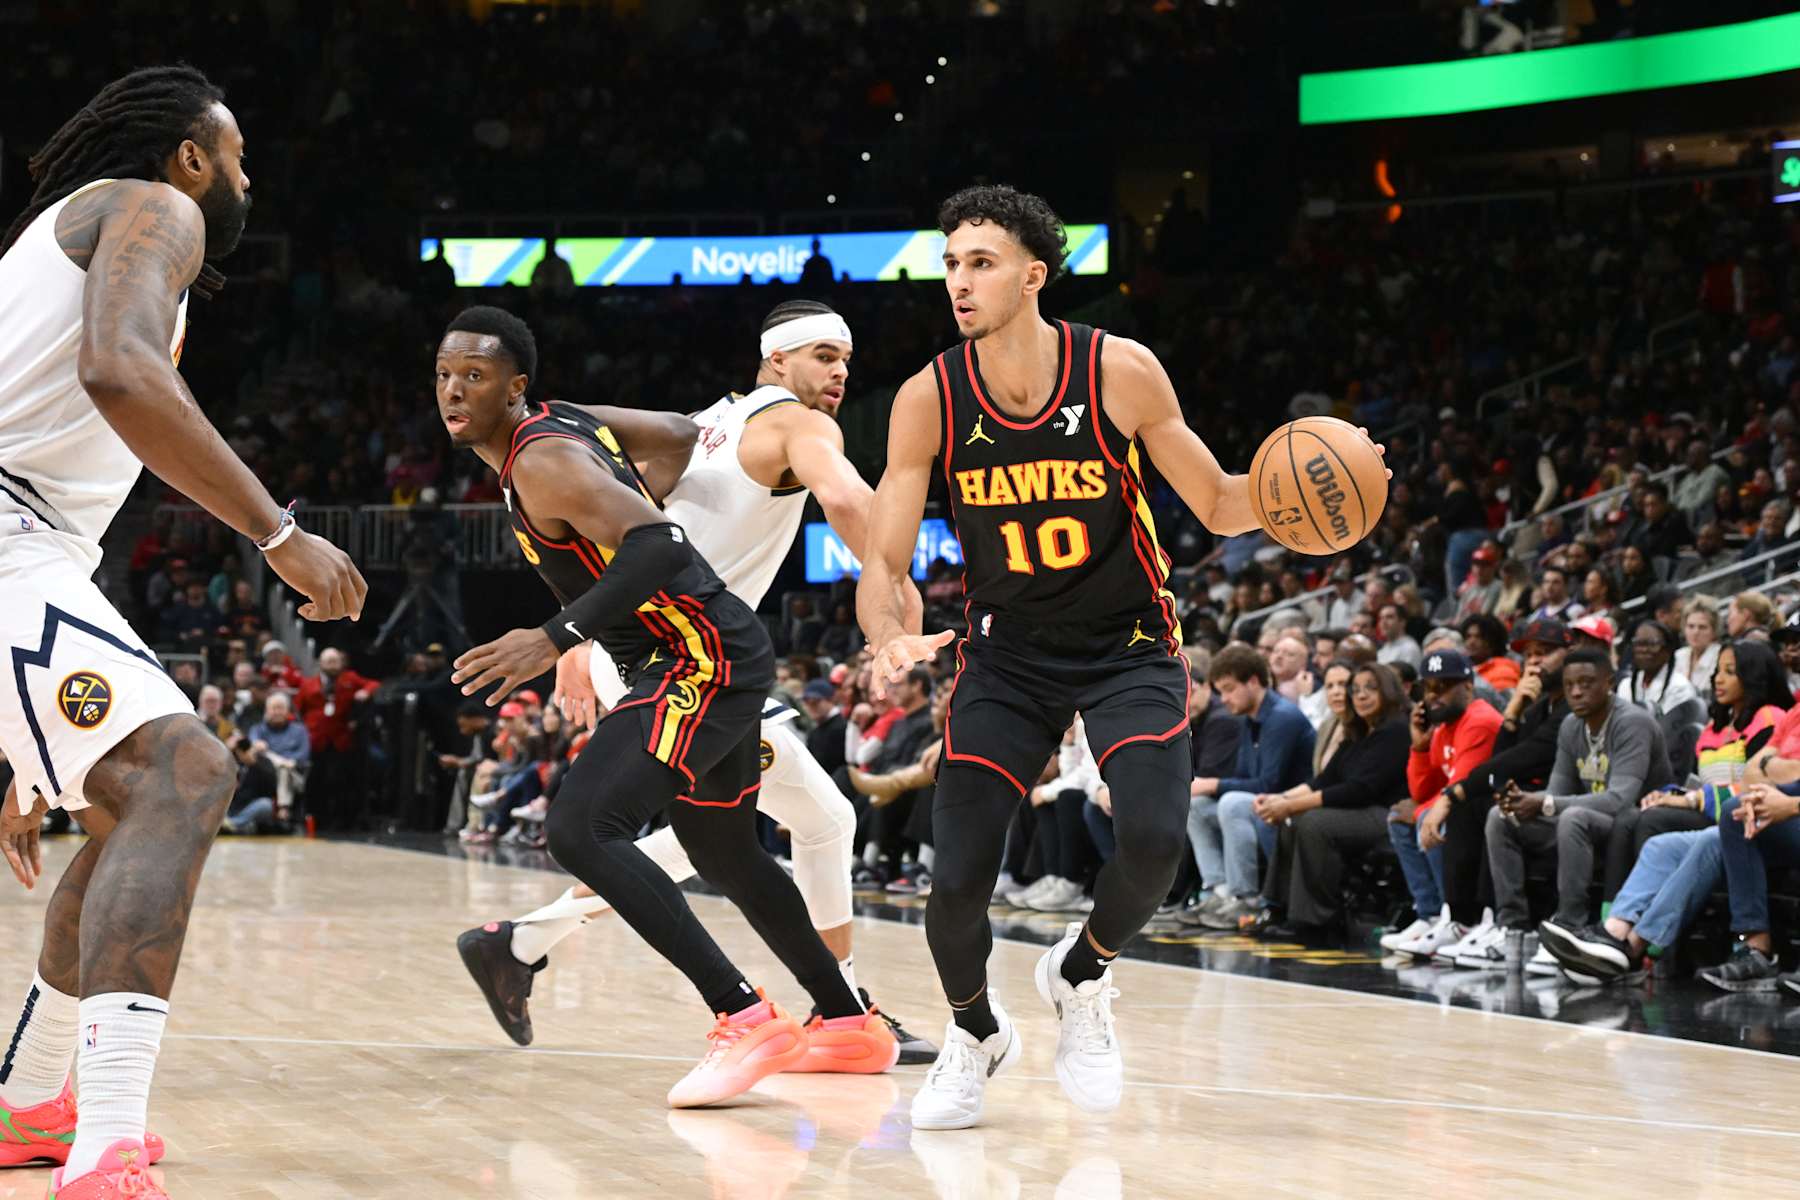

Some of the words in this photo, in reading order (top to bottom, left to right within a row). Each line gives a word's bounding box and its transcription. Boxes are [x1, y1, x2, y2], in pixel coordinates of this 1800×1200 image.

[692, 245, 811, 276] Novelis
[955, 459, 1108, 506] HAWKS
[1305, 453, 1351, 542] Wilson
[999, 516, 1092, 576] 10
